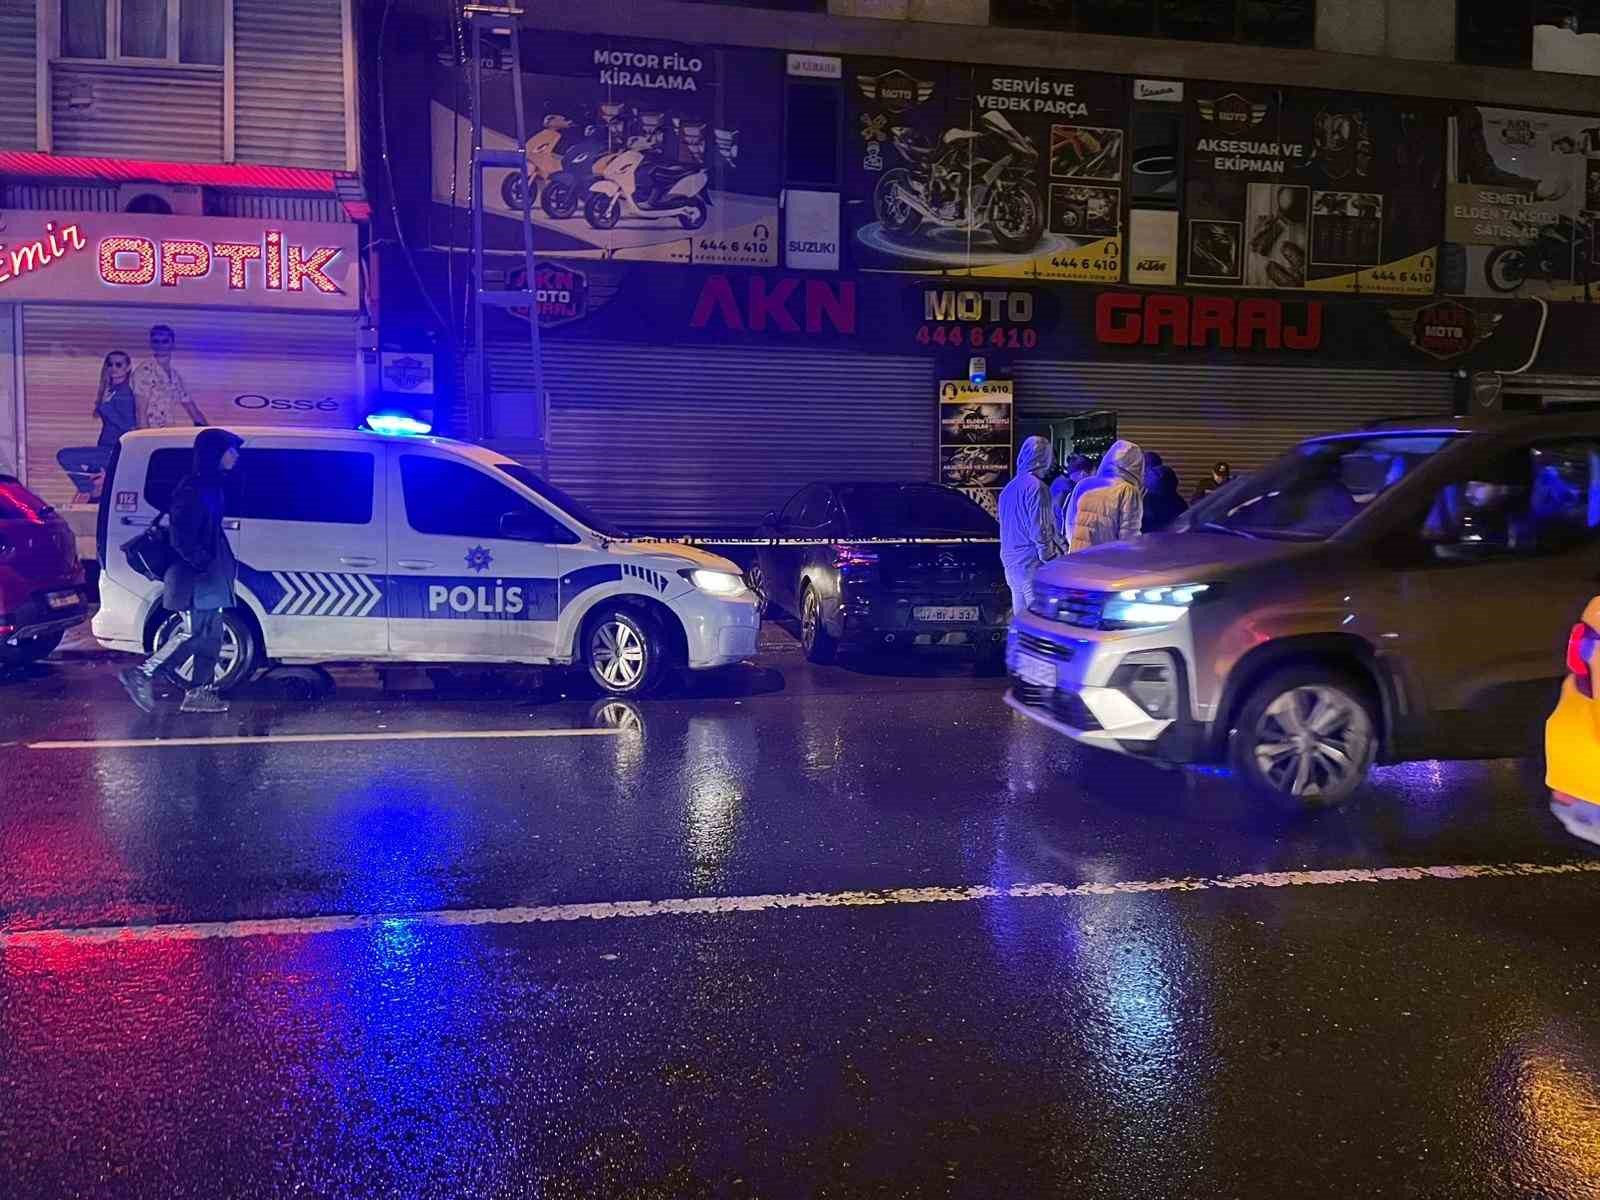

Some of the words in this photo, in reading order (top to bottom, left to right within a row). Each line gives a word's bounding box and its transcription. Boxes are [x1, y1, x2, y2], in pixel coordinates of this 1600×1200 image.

[593, 50, 658, 69] MOTOR
[663, 52, 702, 72] FİLO
[600, 67, 697, 92] KİRALAMA
[992, 77, 1048, 95] SERVİS
[1052, 83, 1074, 97] VE
[881, 88, 912, 99] MOTO
[977, 95, 1030, 112] YEDEK
[1034, 99, 1089, 119] PARÇA
[1218, 111, 1247, 122] MOTO
[1196, 138, 1279, 156] AKSESUAR
[1281, 143, 1303, 157] VE
[1214, 154, 1284, 173] EKİPMAN
[699, 240, 727, 252] 444
[730, 242, 739, 252] 6
[743, 243, 768, 254] 410
[788, 241, 836, 254] SUZUKI
[97, 231, 346, 297] OPTİK
[1051, 257, 1077, 270] 444
[1081, 259, 1090, 270] 6
[1094, 260, 1116, 272] 410
[1372, 272, 1396, 281] 444
[1399, 272, 1407, 282] 6
[1410, 272, 1432, 284] 410
[690, 275, 856, 336] AKN
[924, 290, 1034, 323] MOTO
[1094, 293, 1321, 350] GARAJ
[916, 326, 963, 347] 444
[970, 327, 985, 348] 6
[991, 327, 1037, 349] 410
[1425, 326, 1464, 339] MOTO
[959, 385, 979, 394] 444
[990, 386, 1008, 395] 410
[235, 395, 339, 412] Ossé
[120, 493, 136, 504] 112
[428, 578, 523, 614] POLİS
